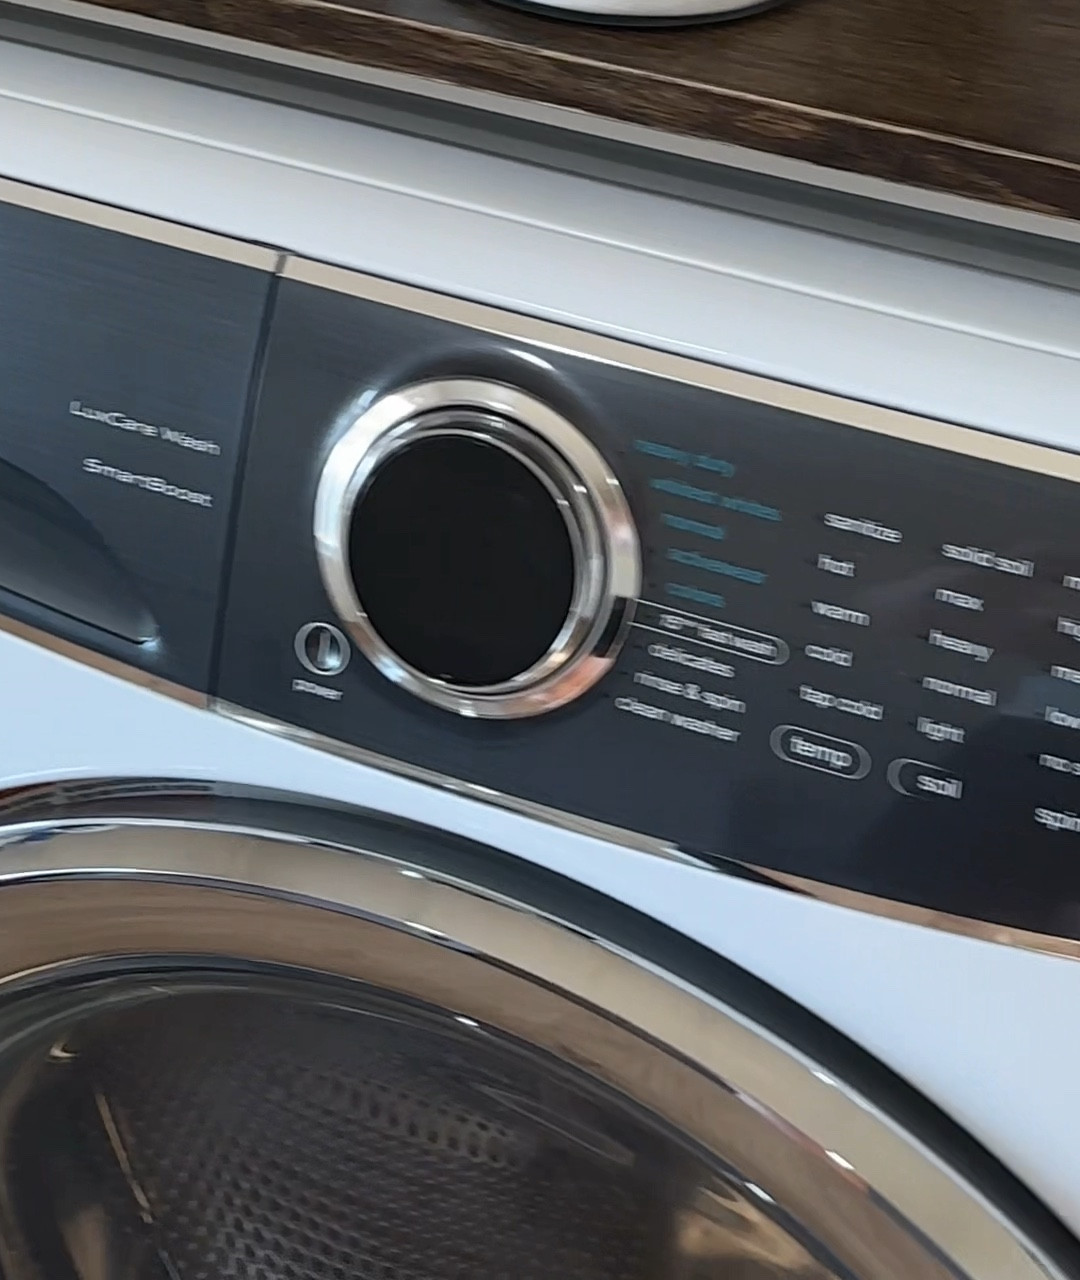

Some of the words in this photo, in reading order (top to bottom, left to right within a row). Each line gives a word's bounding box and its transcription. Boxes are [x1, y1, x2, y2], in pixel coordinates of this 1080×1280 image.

[69, 399, 158, 438] LuxCare
[159, 425, 221, 456] Wash
[82, 457, 213, 508] SmartBoost
[817, 553, 856, 577] hot
[935, 588, 985, 611] max
[811, 600, 871, 627] warm
[804, 643, 854, 668] cold
[928, 628, 995, 663] heavy
[292, 677, 345, 701] power
[922, 677, 998, 707] normal
[789, 734, 853, 770] temp
[916, 774, 963, 799] soil
